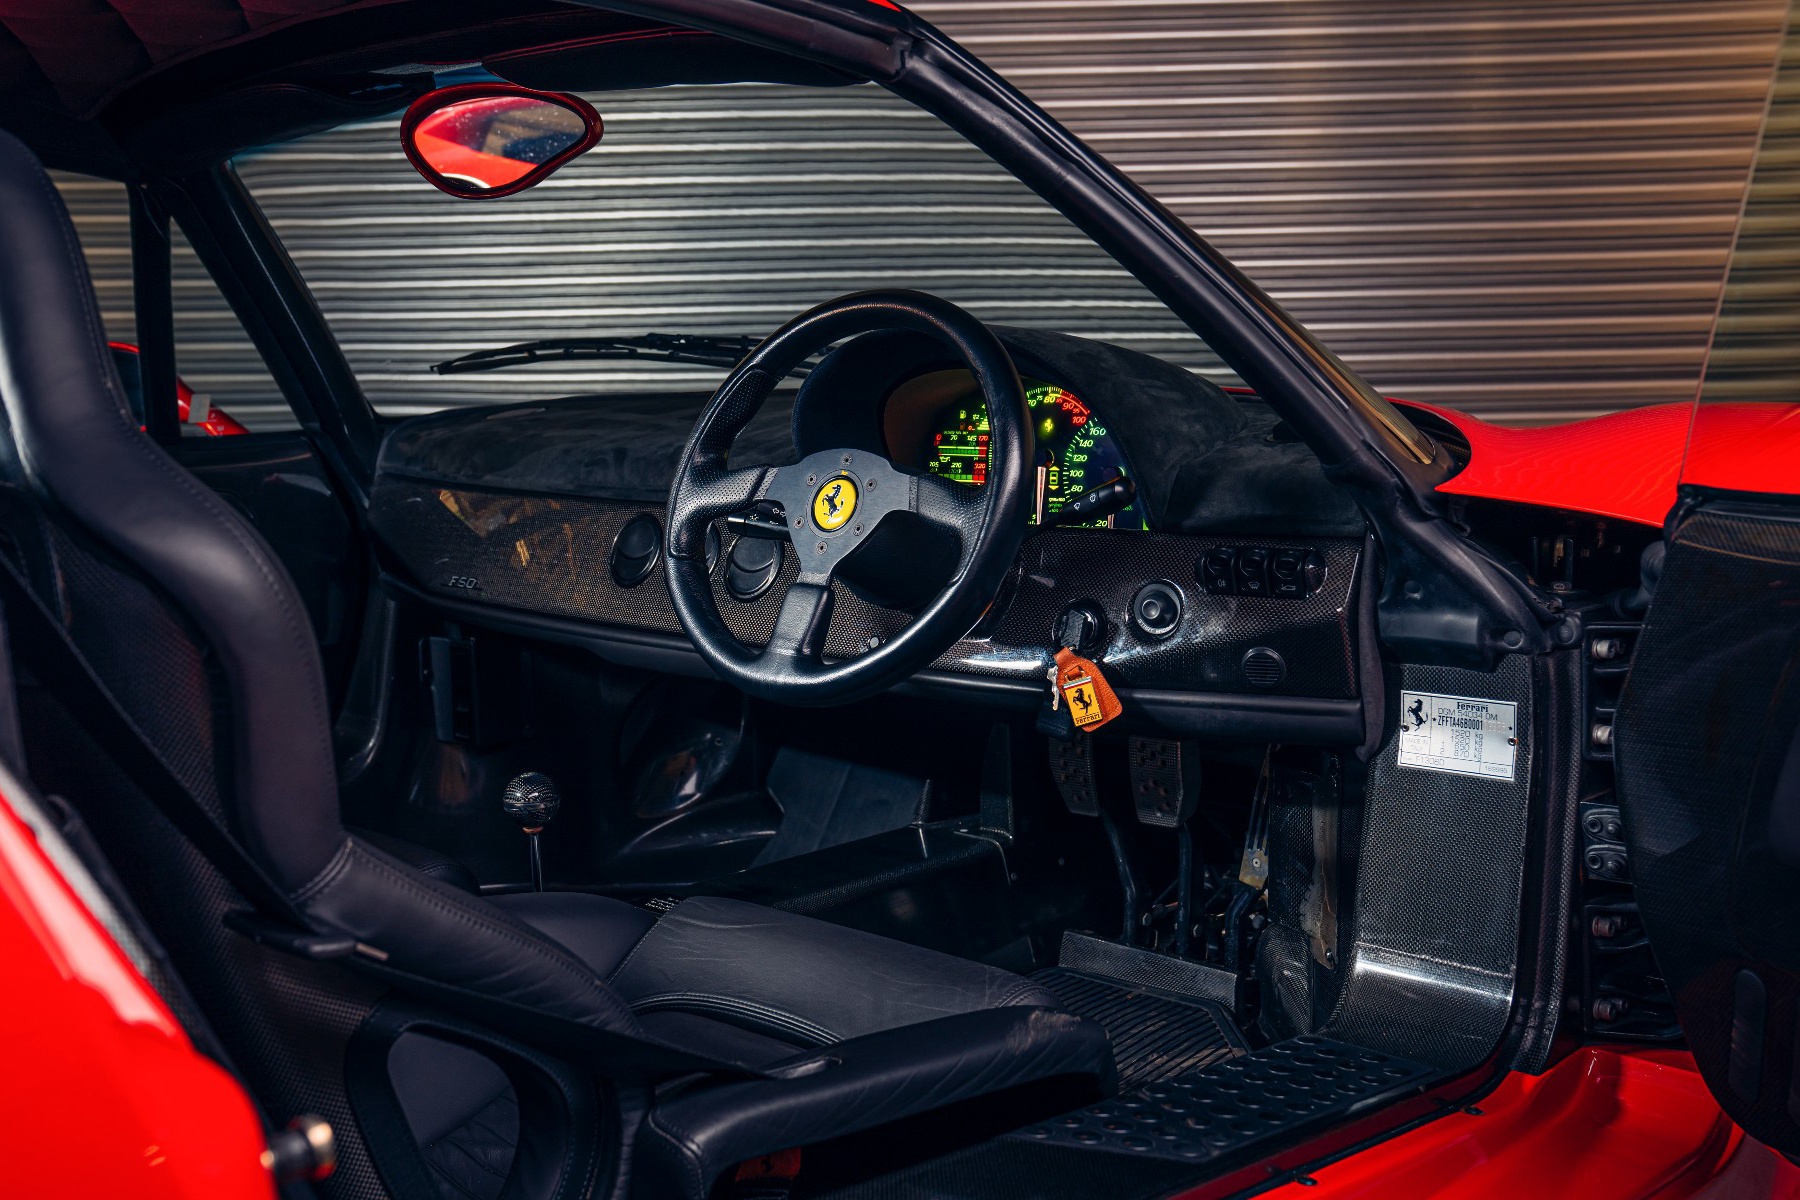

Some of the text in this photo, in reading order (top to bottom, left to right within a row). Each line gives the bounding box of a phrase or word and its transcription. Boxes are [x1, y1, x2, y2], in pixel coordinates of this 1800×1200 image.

[1043, 395, 1056, 403] 80
[1062, 402, 1075, 410] 90
[1072, 416, 1087, 424] 100
[1089, 426, 1106, 436] 160
[1079, 439, 1094, 448] 140
[1072, 454, 1087, 462] 120
[1069, 469, 1084, 477] 100
[1094, 519, 1108, 527] 20
[1456, 702, 1489, 713] Ferrari
[1076, 712, 1101, 724] Ferrari
